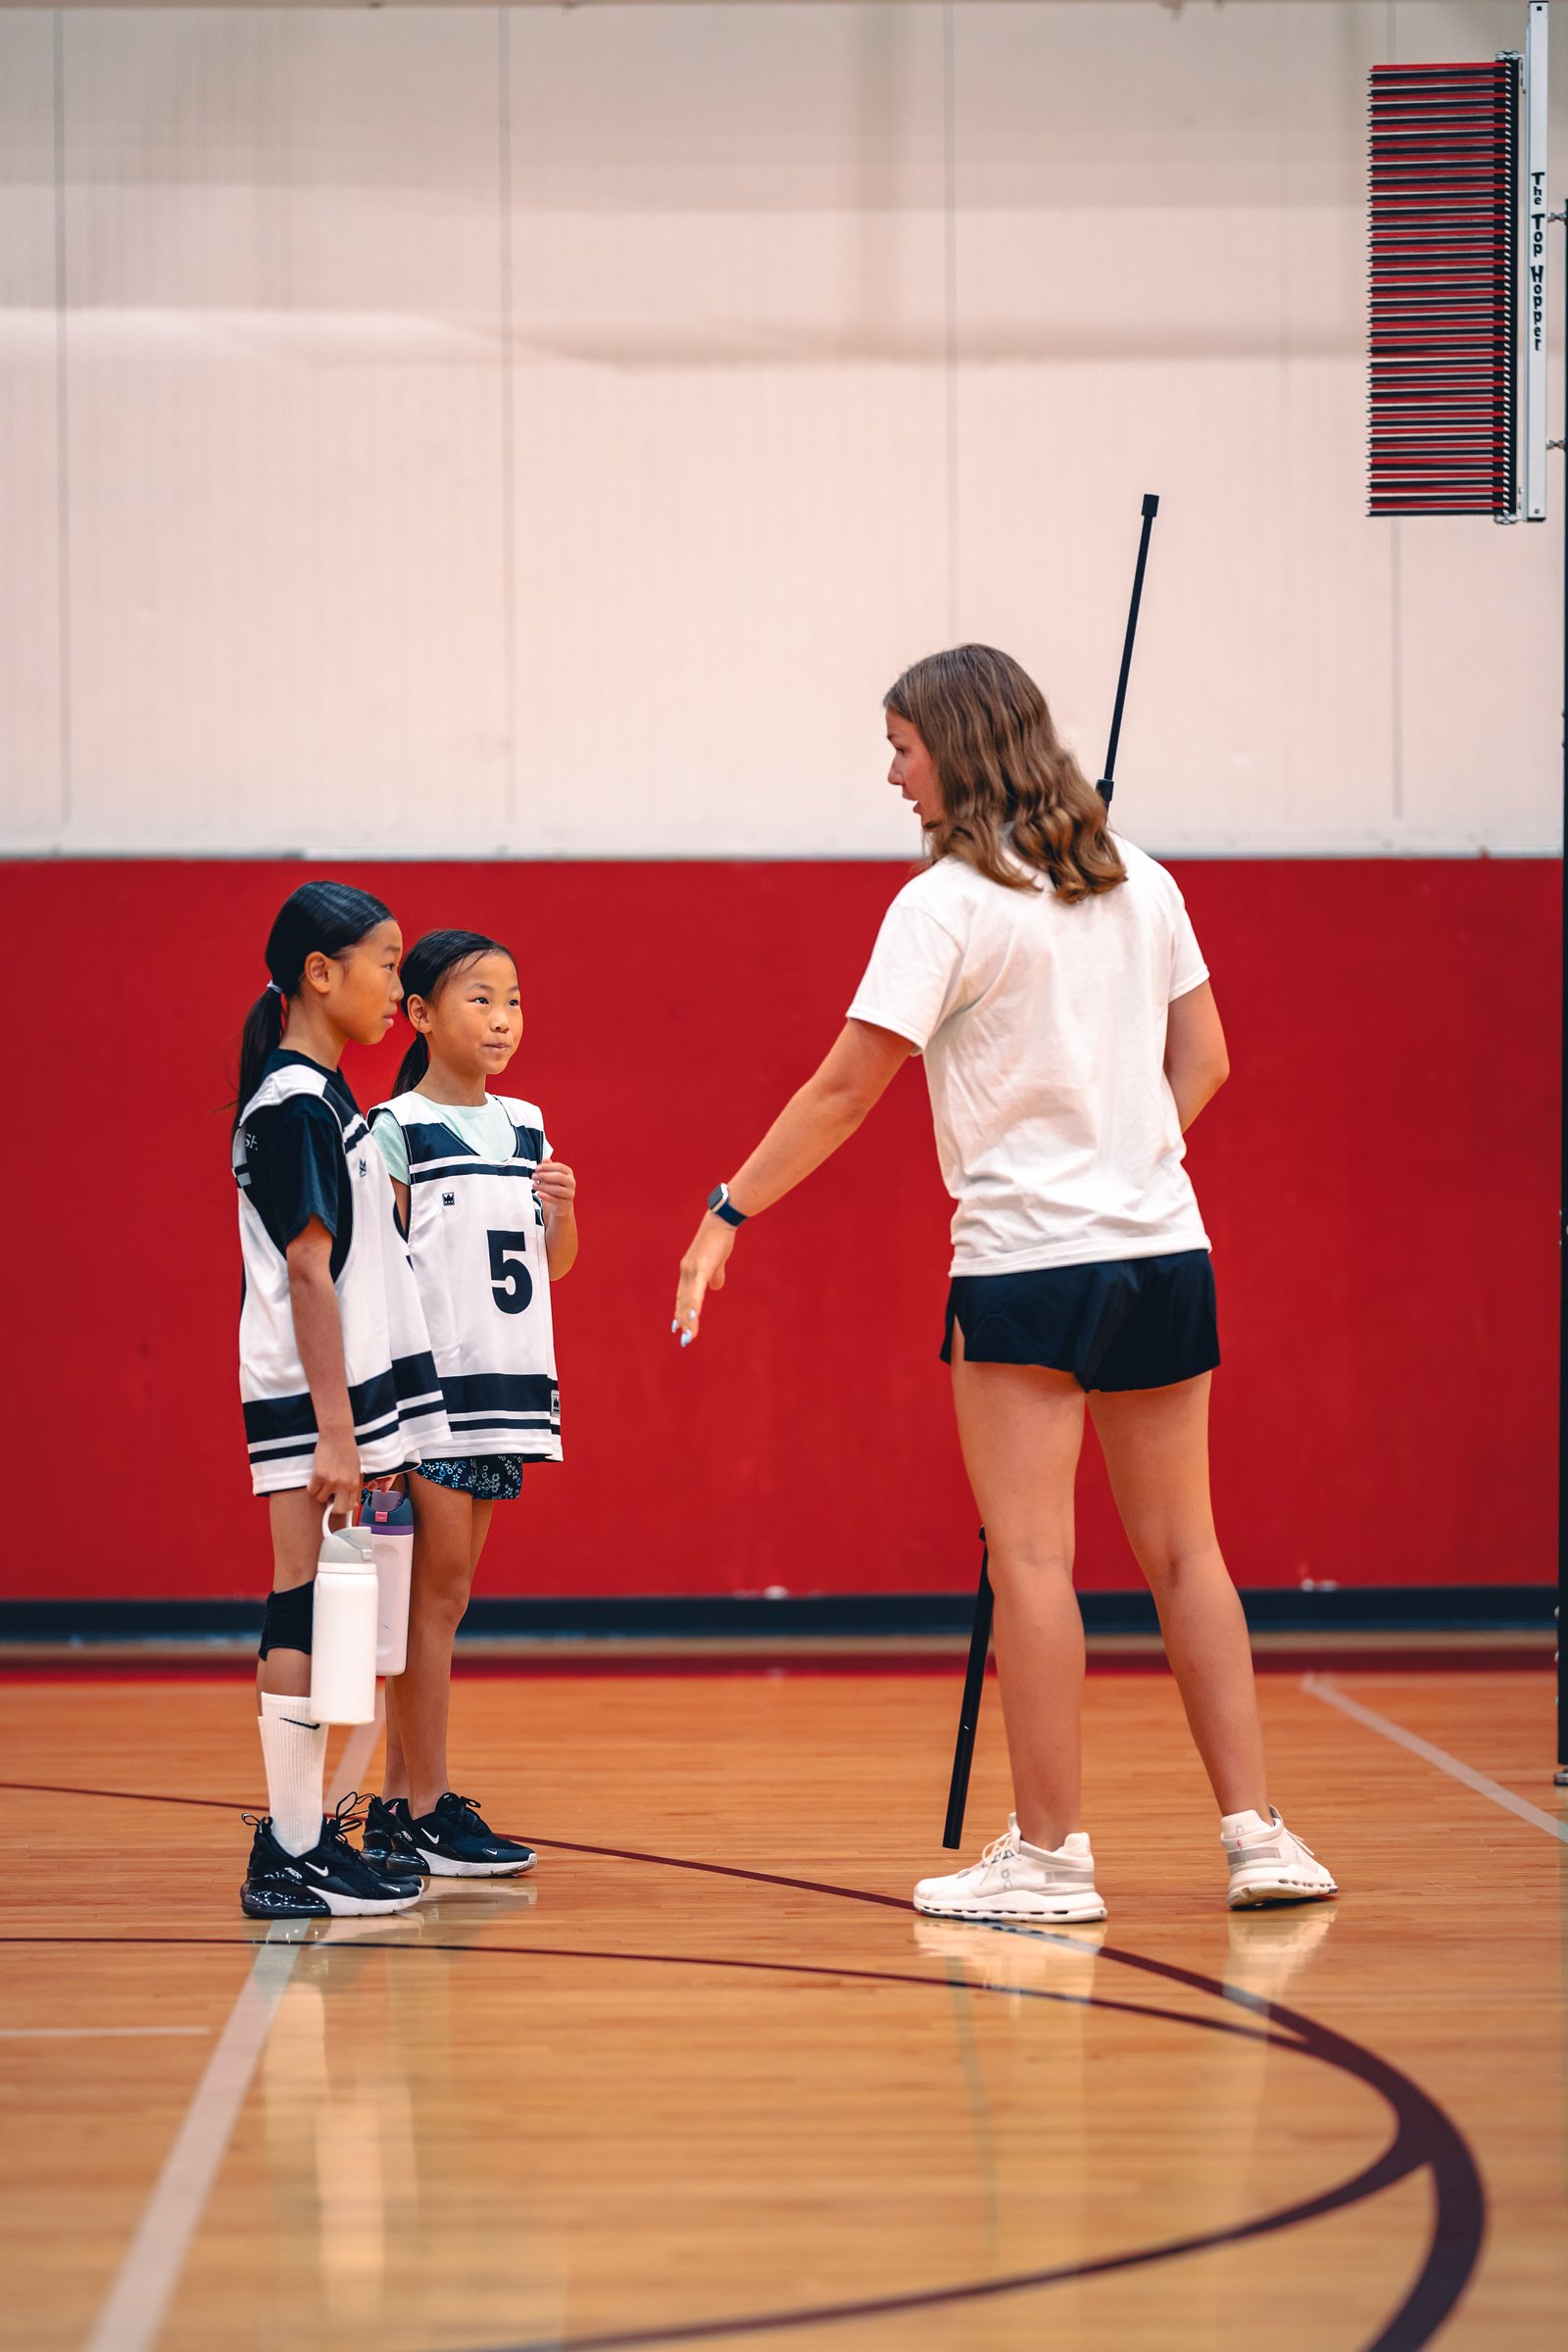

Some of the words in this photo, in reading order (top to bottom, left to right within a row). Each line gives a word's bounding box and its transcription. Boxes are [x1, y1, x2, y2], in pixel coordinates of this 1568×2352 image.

[1531, 172, 1545, 205] The
[1531, 213, 1545, 258] Top
[486, 1229, 533, 1315] 5
